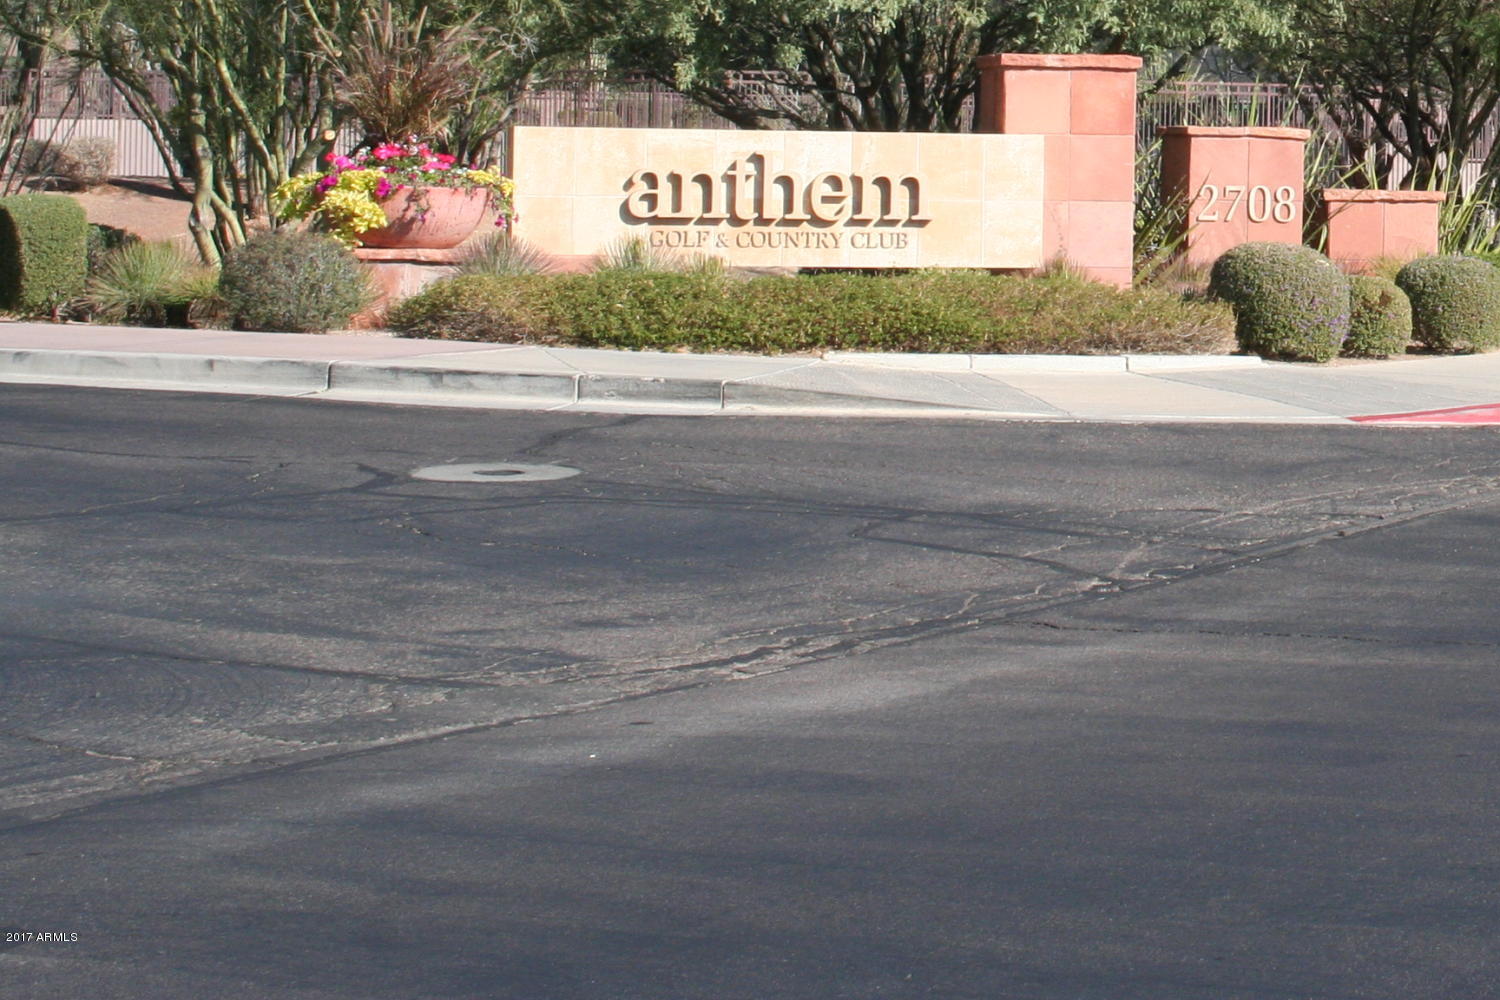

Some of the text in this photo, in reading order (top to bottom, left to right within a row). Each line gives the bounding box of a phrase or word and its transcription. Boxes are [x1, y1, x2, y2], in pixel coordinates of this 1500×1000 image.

[621, 152, 931, 225] anthem
[1197, 185, 1296, 223] 2708
[649, 230, 908, 249] GOLF & COUNTRY CLUB
